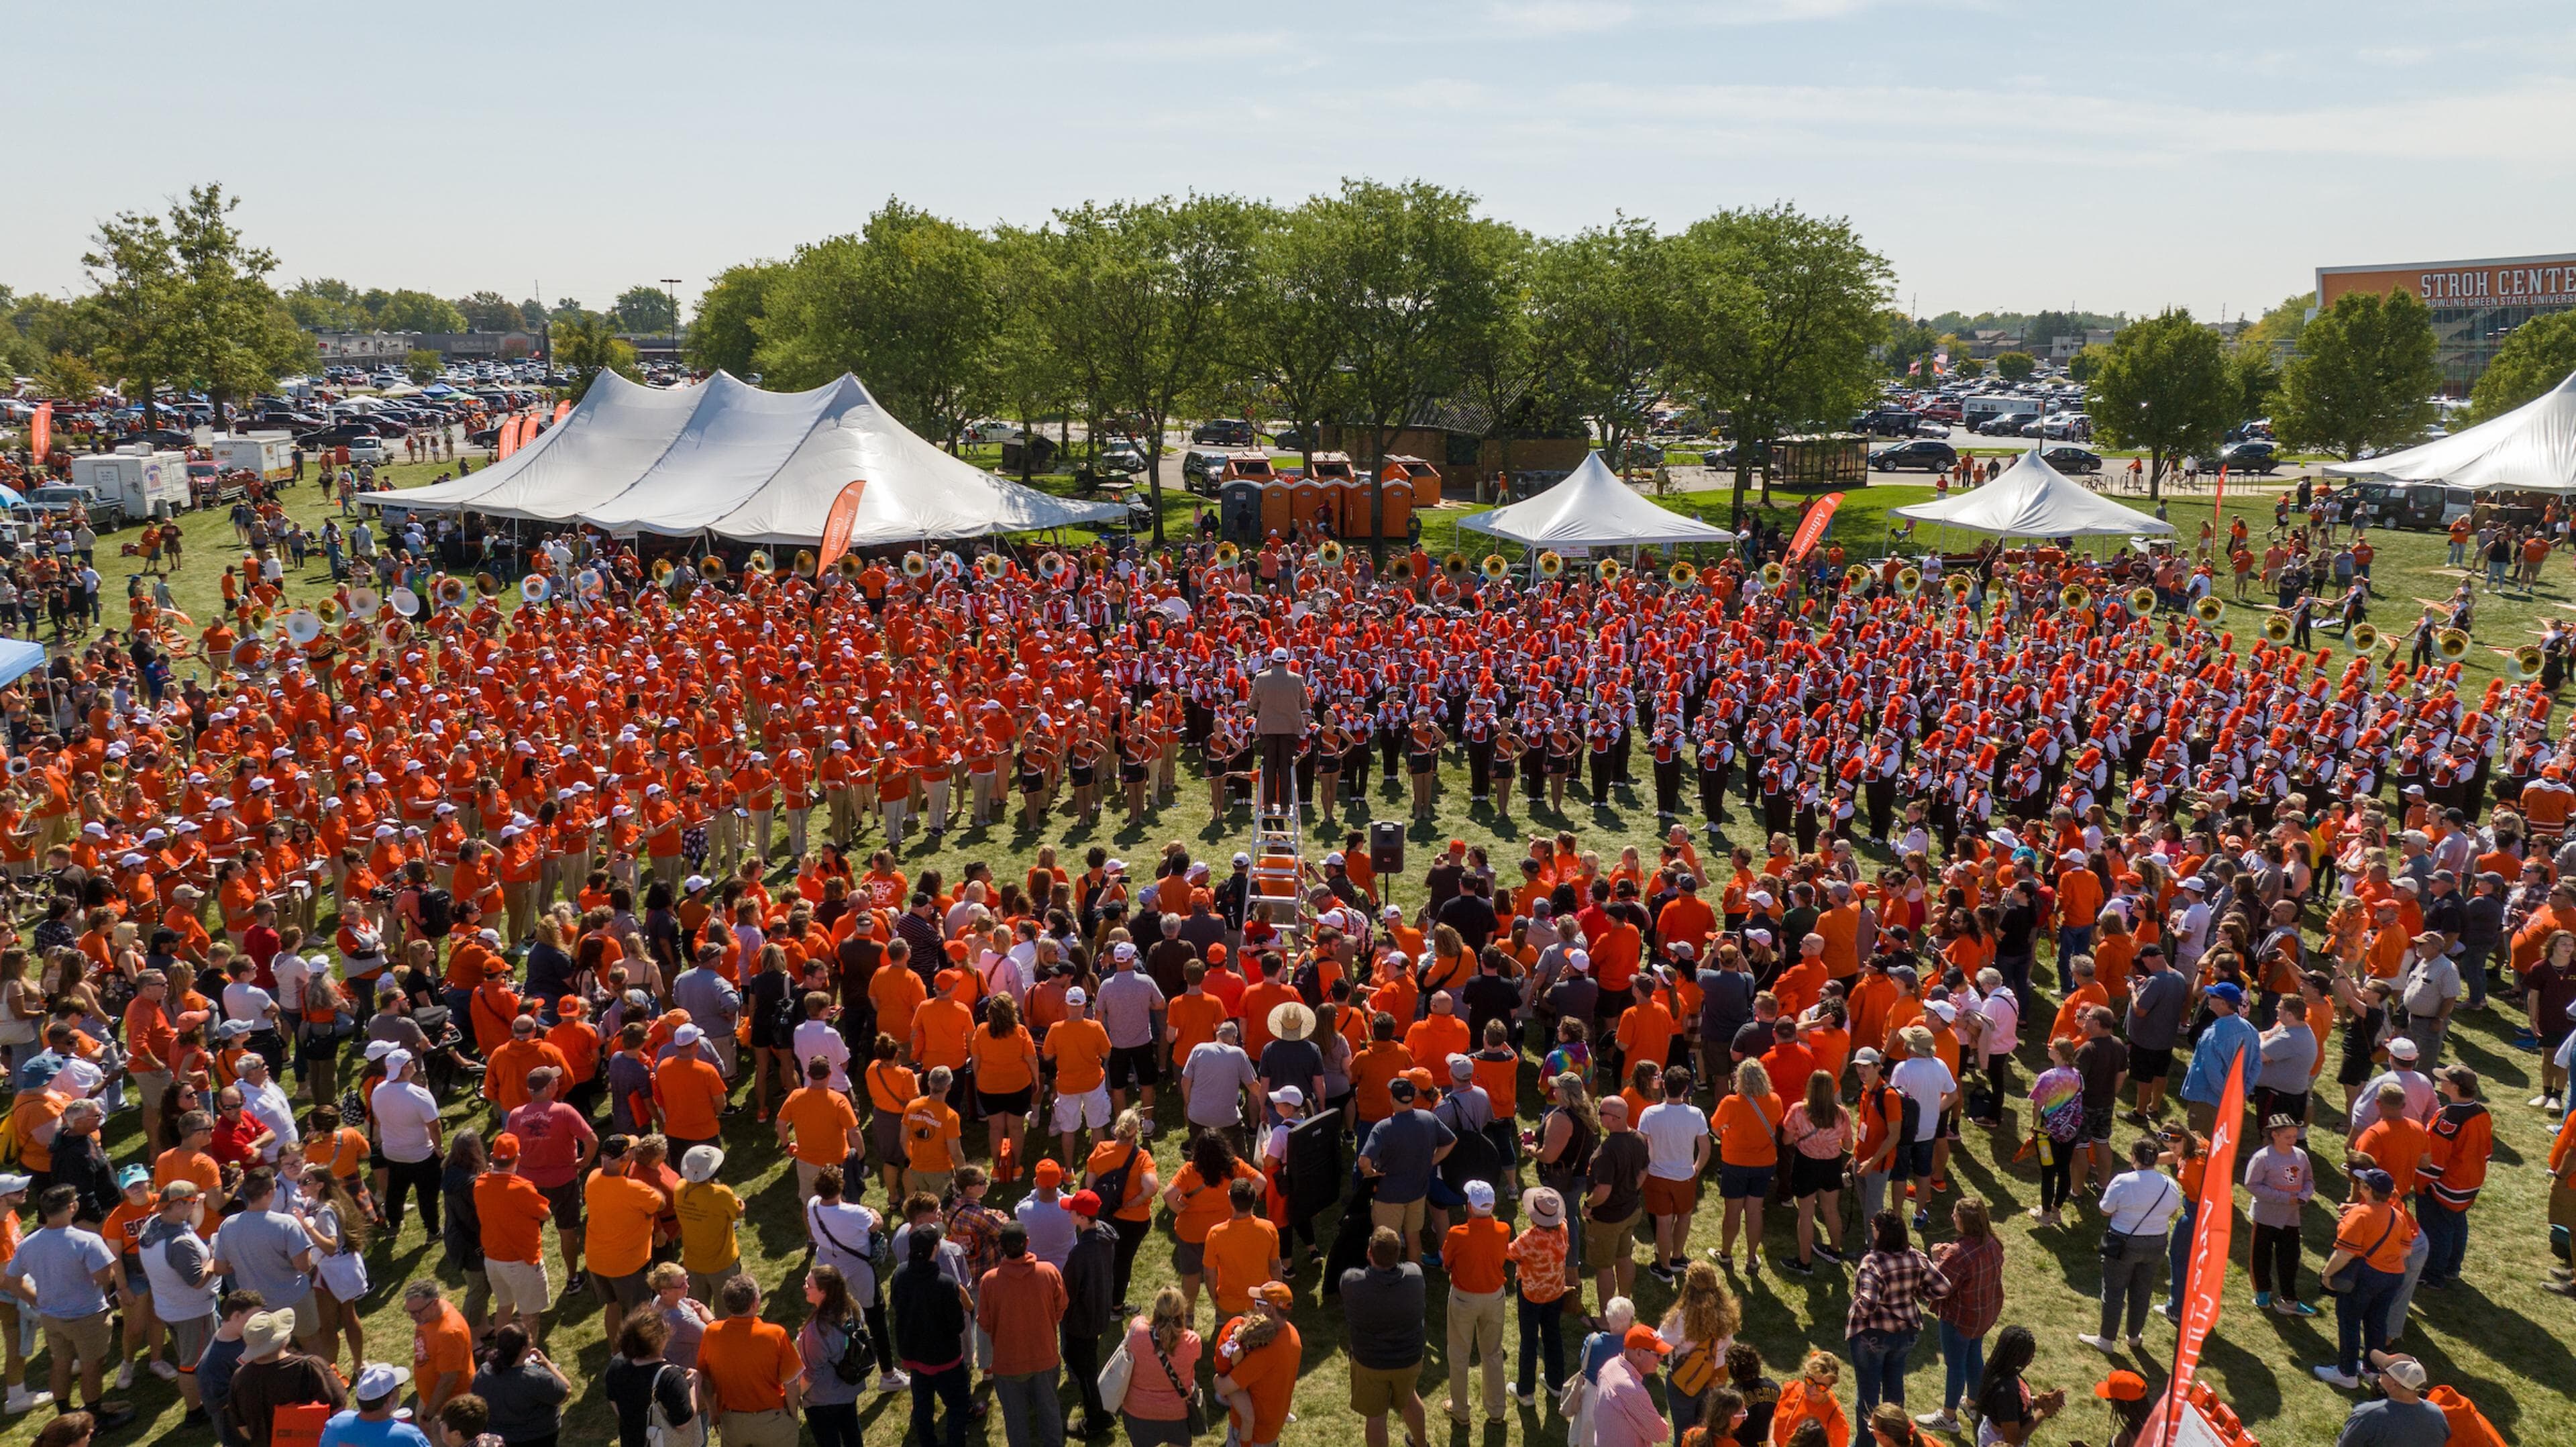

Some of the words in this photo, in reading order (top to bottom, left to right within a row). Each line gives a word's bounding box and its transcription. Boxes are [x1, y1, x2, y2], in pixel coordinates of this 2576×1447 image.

[2421, 271, 2489, 298] STROH
[2426, 298, 2466, 307] BOWLING
[2468, 297, 2498, 307] GREEN
[2500, 295, 2528, 305] STATE
[828, 517, 843, 551] Council
[1796, 507, 1826, 556] Admissio
